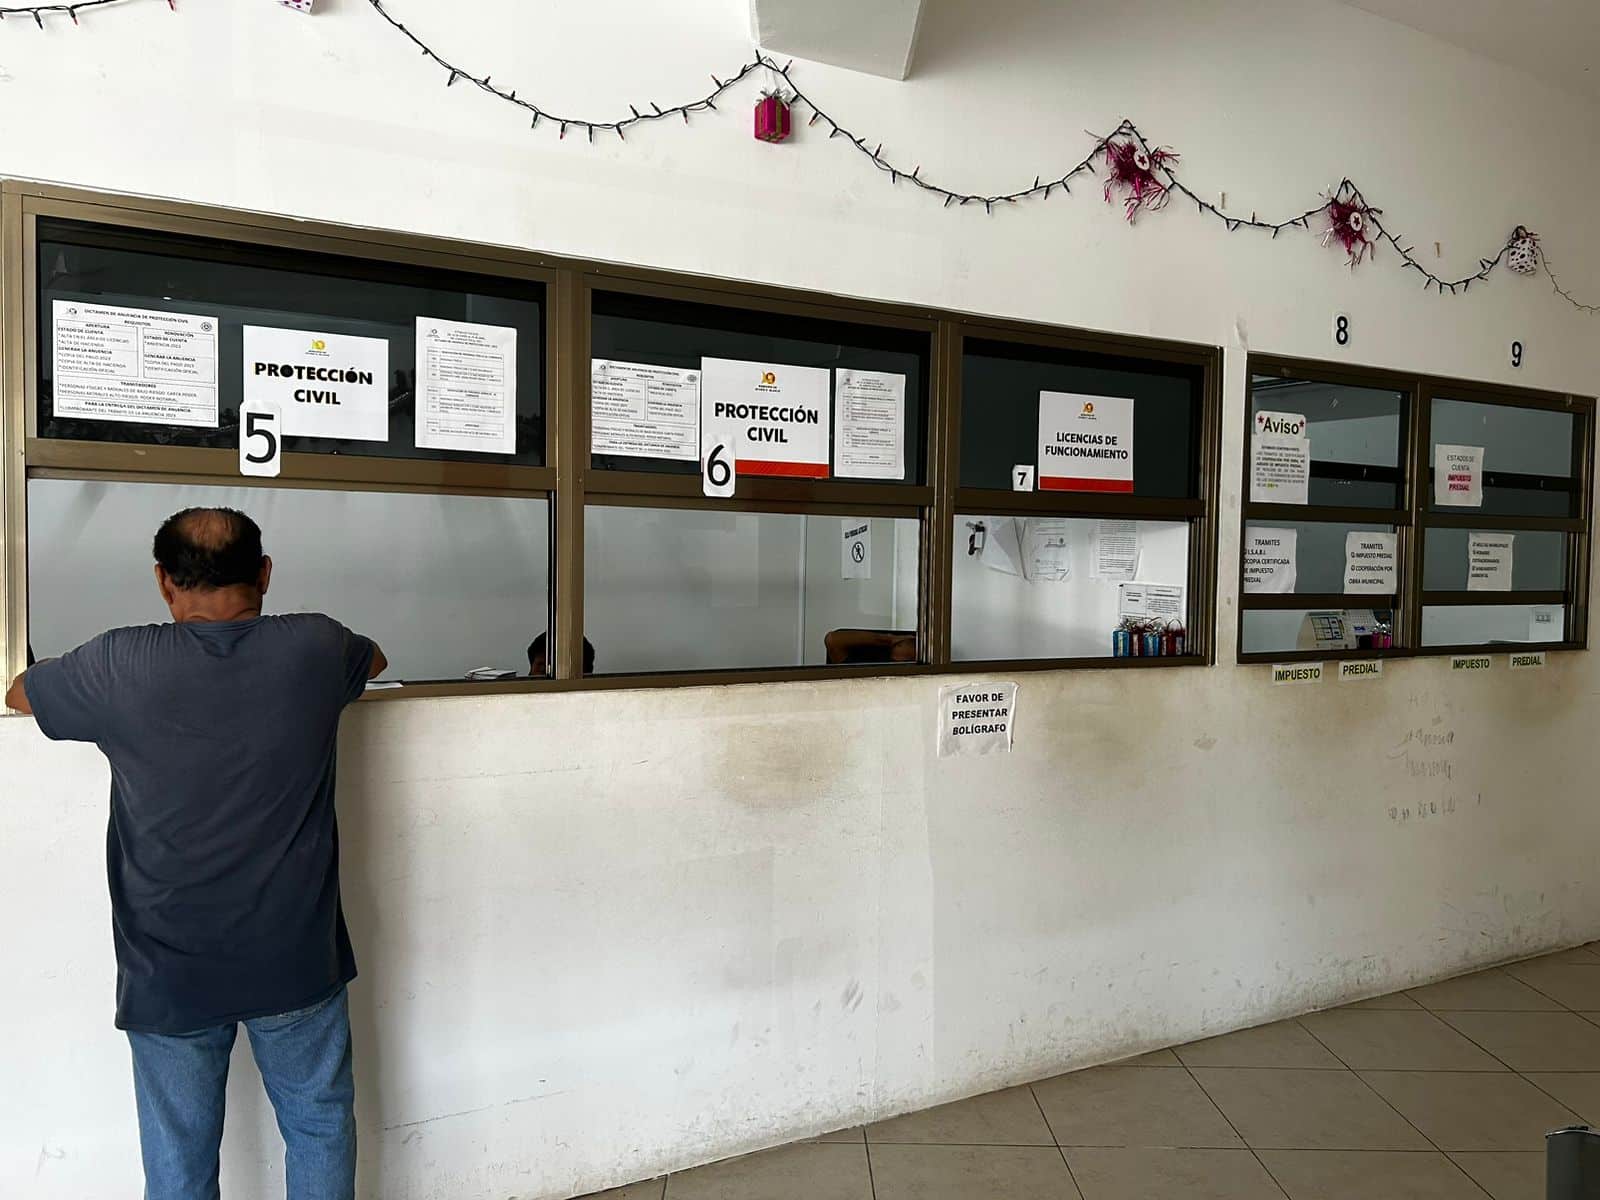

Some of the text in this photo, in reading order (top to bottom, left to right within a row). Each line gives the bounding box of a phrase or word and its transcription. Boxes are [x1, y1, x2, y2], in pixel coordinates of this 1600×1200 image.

[1335, 315, 1349, 345] 8
[1511, 340, 1523, 367] 9
[254, 361, 373, 385] PROTECCIÓN
[294, 389, 341, 405] CIVIL
[714, 402, 818, 424] PROTECCIÓN
[245, 411, 277, 464] 5
[747, 427, 788, 443] CIVIL
[1056, 432, 1118, 446] LICENCIAS DE
[1045, 445, 1129, 460] FUNCIONAMIENTO
[707, 444, 731, 487] 6
[1017, 471, 1027, 486] 7
[1453, 656, 1542, 670] IMPUESTO PREDIAL
[1275, 663, 1378, 681] IMPUESTO PREDIAL
[956, 693, 1004, 704] FAVOR DE
[952, 708, 1008, 720] PRESENTAR
[952, 723, 1006, 735] BOLÍGRAFO
